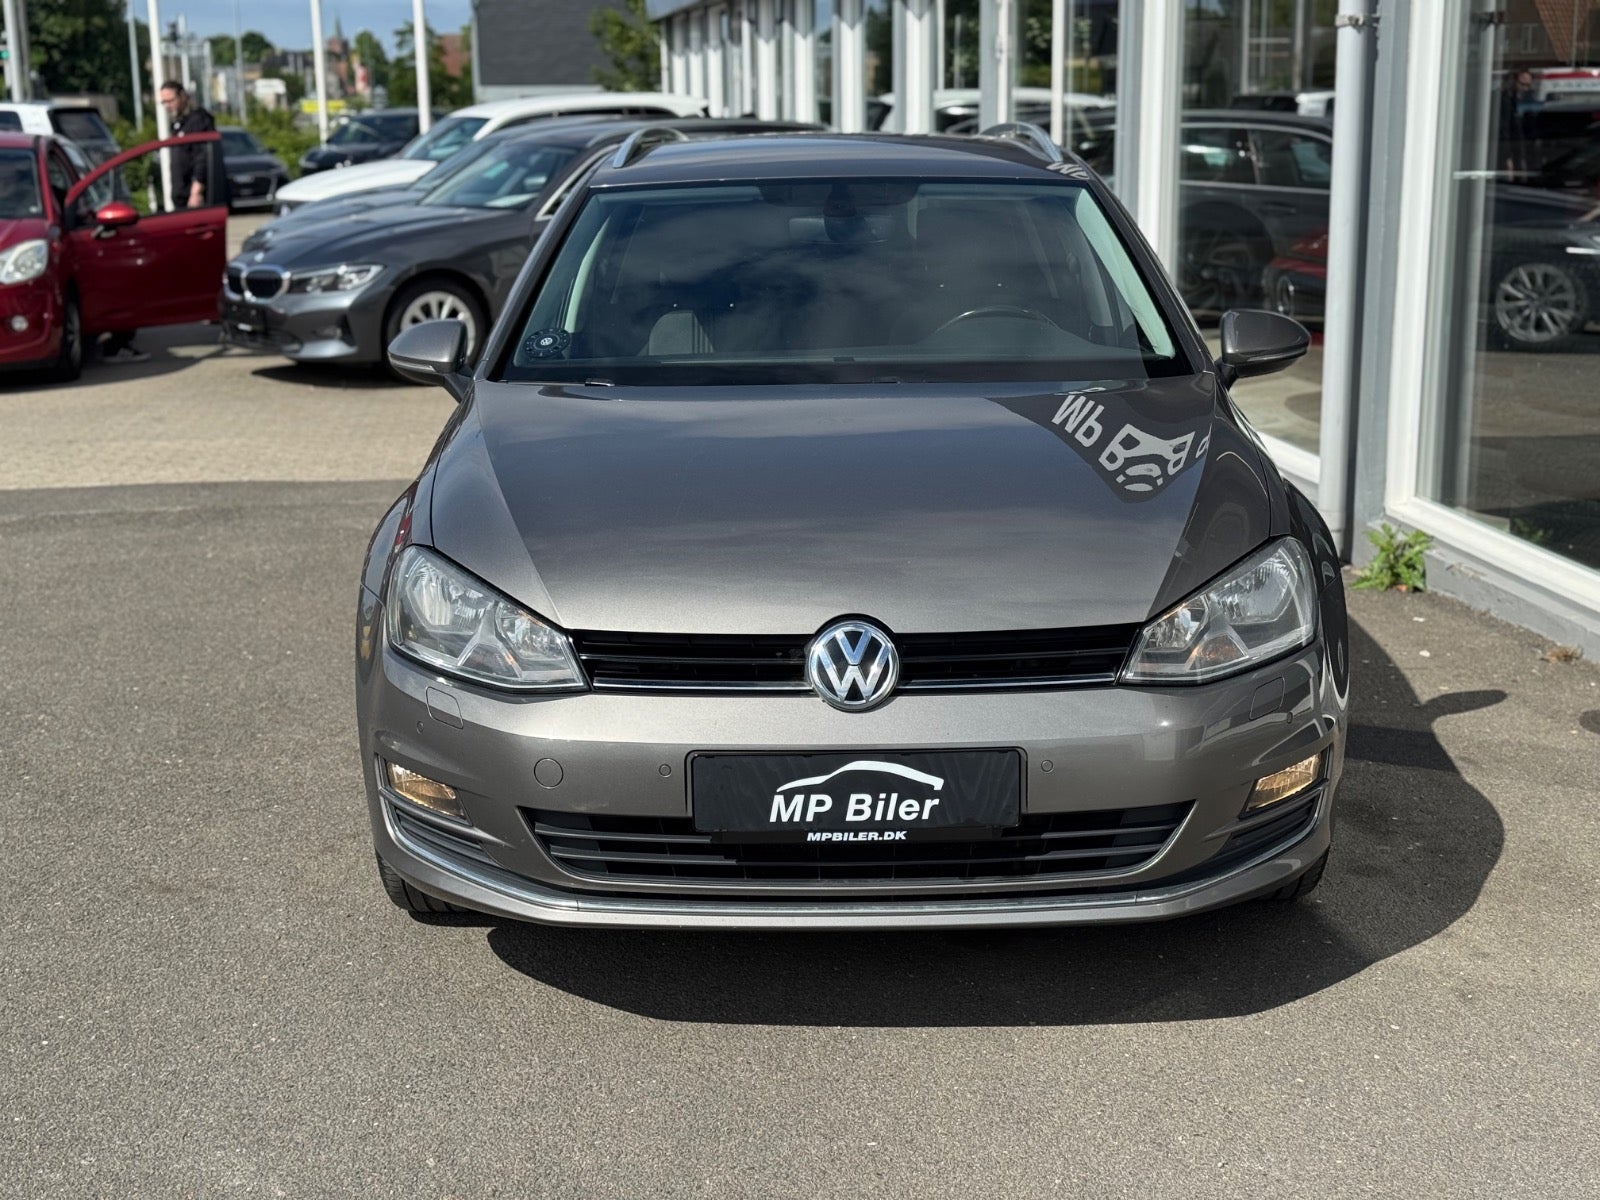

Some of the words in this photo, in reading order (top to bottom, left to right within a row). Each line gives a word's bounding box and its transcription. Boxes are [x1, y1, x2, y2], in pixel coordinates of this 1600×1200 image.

[812, 624, 896, 706] VW
[769, 793, 833, 823] MP
[845, 792, 940, 822] Biler
[806, 830, 908, 842] MPBILER.DK
